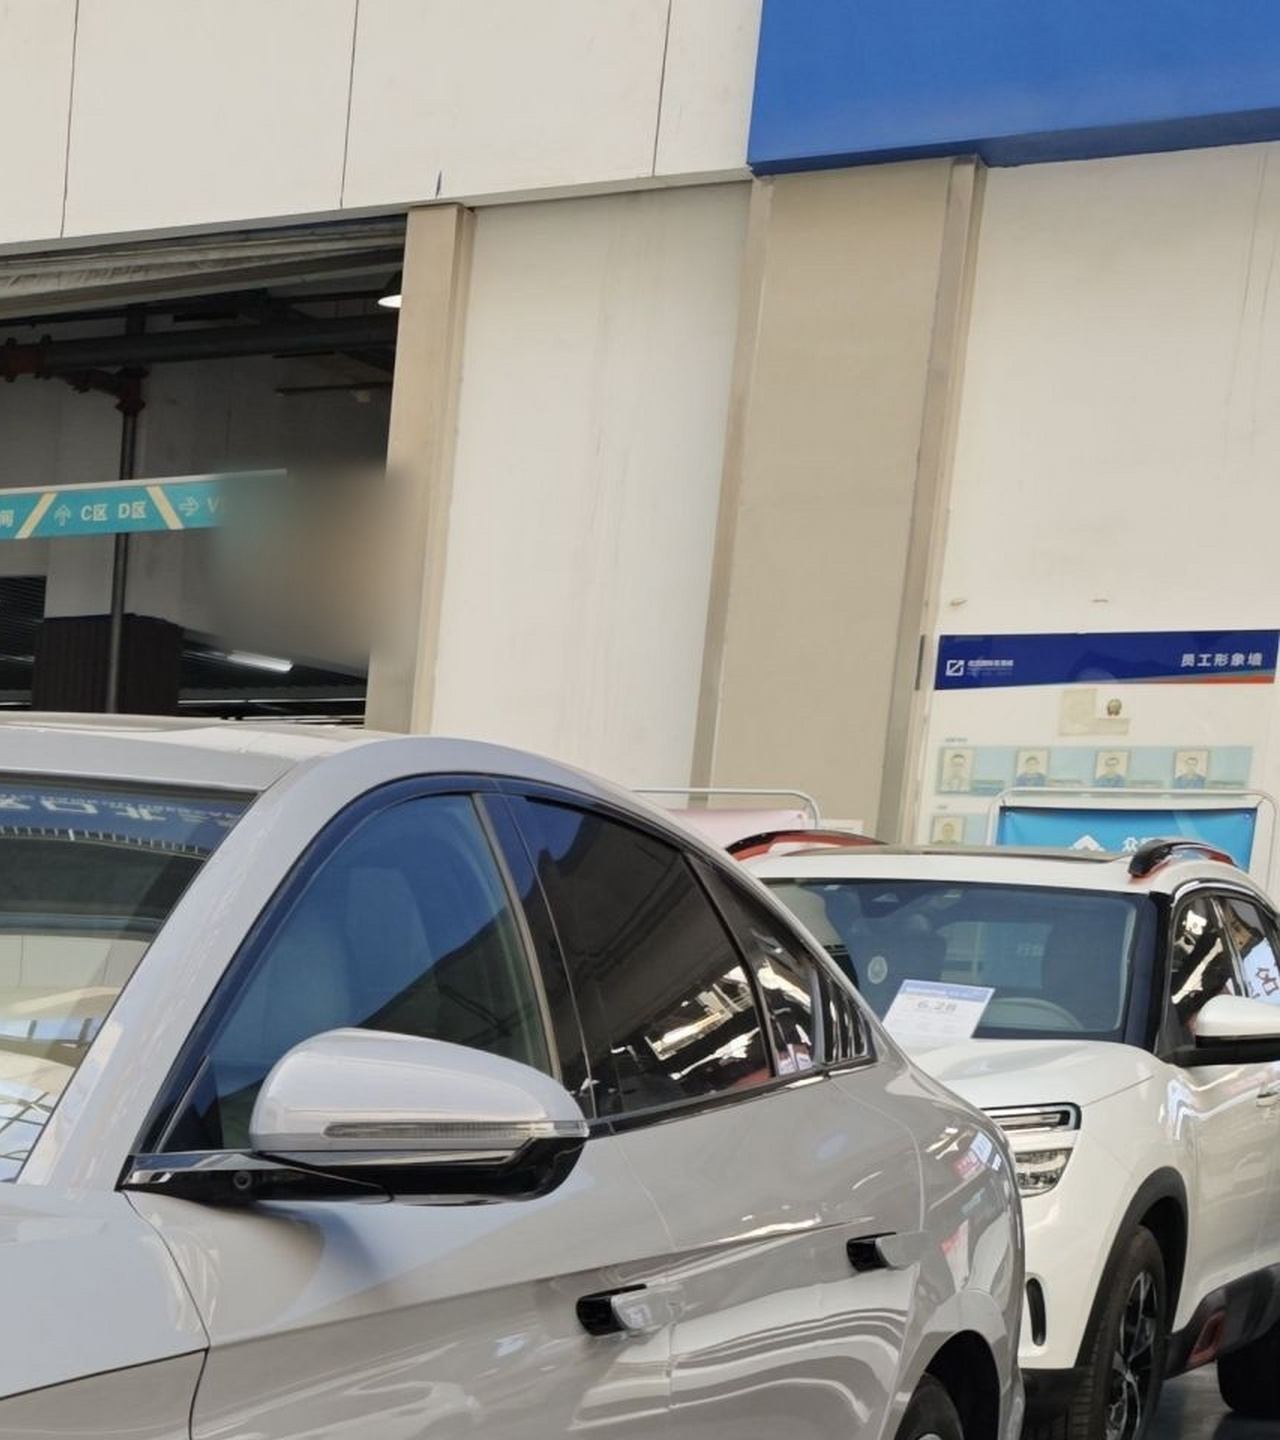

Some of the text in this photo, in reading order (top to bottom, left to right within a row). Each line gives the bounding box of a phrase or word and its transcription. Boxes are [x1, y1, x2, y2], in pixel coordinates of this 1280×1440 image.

[80, 500, 147, 521] C区 D区
[1180, 651, 1264, 668] 员工形象墙
